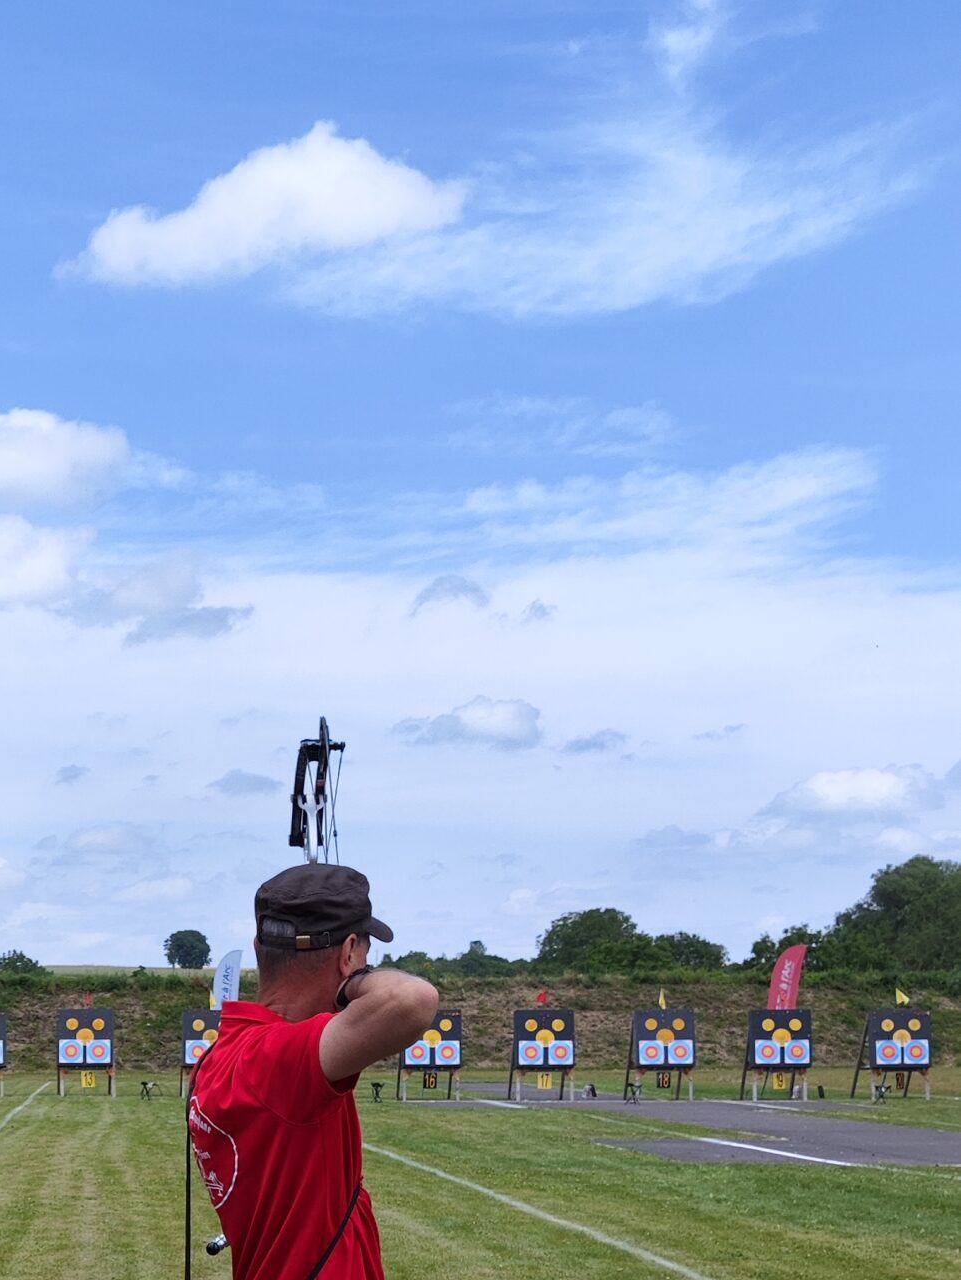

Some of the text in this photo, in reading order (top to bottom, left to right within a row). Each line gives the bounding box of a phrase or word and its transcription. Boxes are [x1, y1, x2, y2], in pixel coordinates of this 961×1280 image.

[83, 1072, 94, 1086] 13
[424, 1073, 436, 1088] 16
[540, 1073, 550, 1088] 17
[658, 1073, 670, 1087] 18
